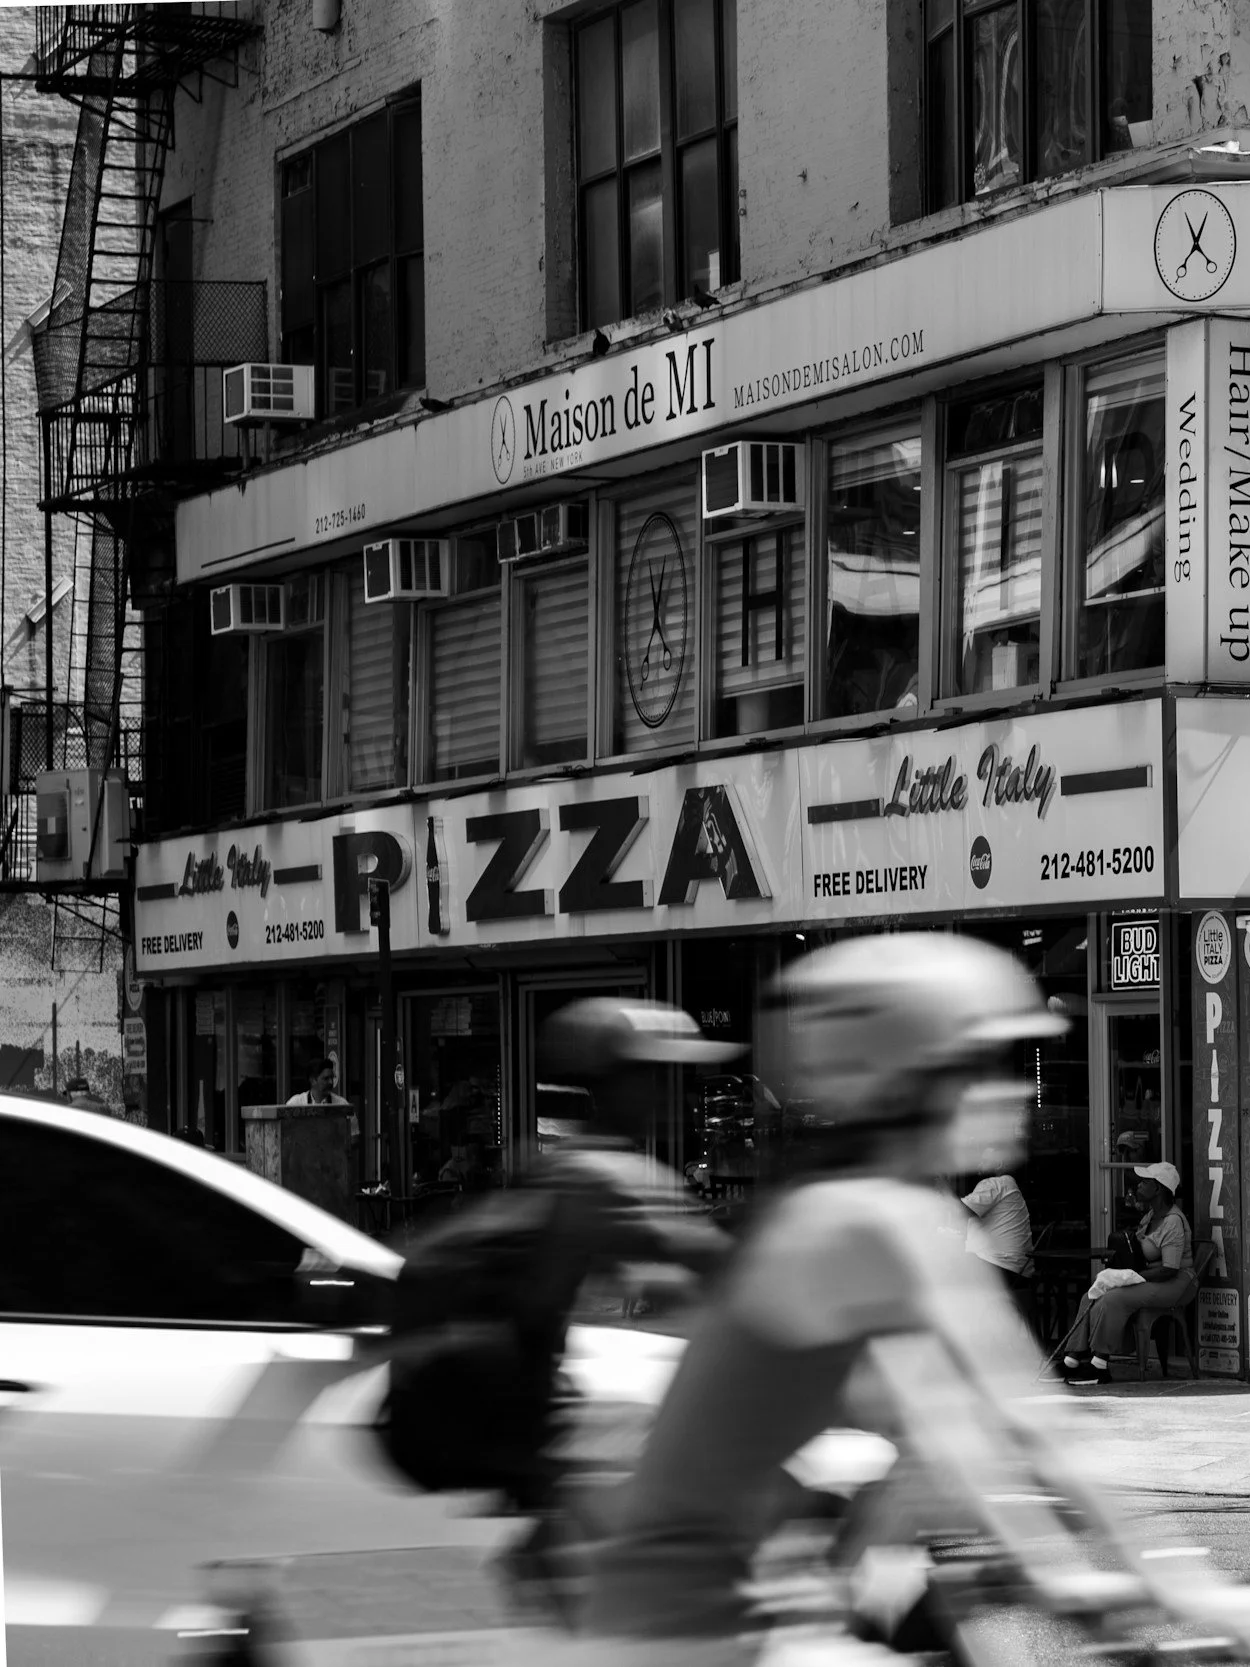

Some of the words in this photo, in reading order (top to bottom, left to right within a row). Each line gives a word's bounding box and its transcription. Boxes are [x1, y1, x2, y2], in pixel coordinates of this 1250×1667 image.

[733, 330, 925, 409] MAISONDEMISALON.COM
[524, 390, 618, 461] Maison
[623, 367, 655, 429] de
[665, 339, 715, 422] MI
[535, 460, 547, 477] AVE
[550, 455, 565, 472] NEW
[566, 450, 583, 468] YORK
[1174, 392, 1198, 584] Wedding
[315, 504, 366, 534] 212-725-1460
[884, 754, 968, 817] Little
[976, 742, 1056, 820] Italy
[333, 784, 773, 935] PIZZA
[1040, 845, 1155, 881] 212-481-5200
[813, 871, 850, 898] FREE
[856, 865, 928, 894] DELIVERY
[141, 936, 161, 956] FREE
[164, 931, 203, 953] DELIVERY
[265, 919, 325, 945] 212-481-5200
[1120, 927, 1157, 956] BUD
[1203, 929, 1223, 943] Little
[1203, 942, 1223, 955] ITALY
[1204, 955, 1223, 966] PIZZA
[1113, 953, 1161, 983] LIGHT
[1200, 1292, 1212, 1305] FREE
[1213, 1292, 1237, 1306] DELIVERY
